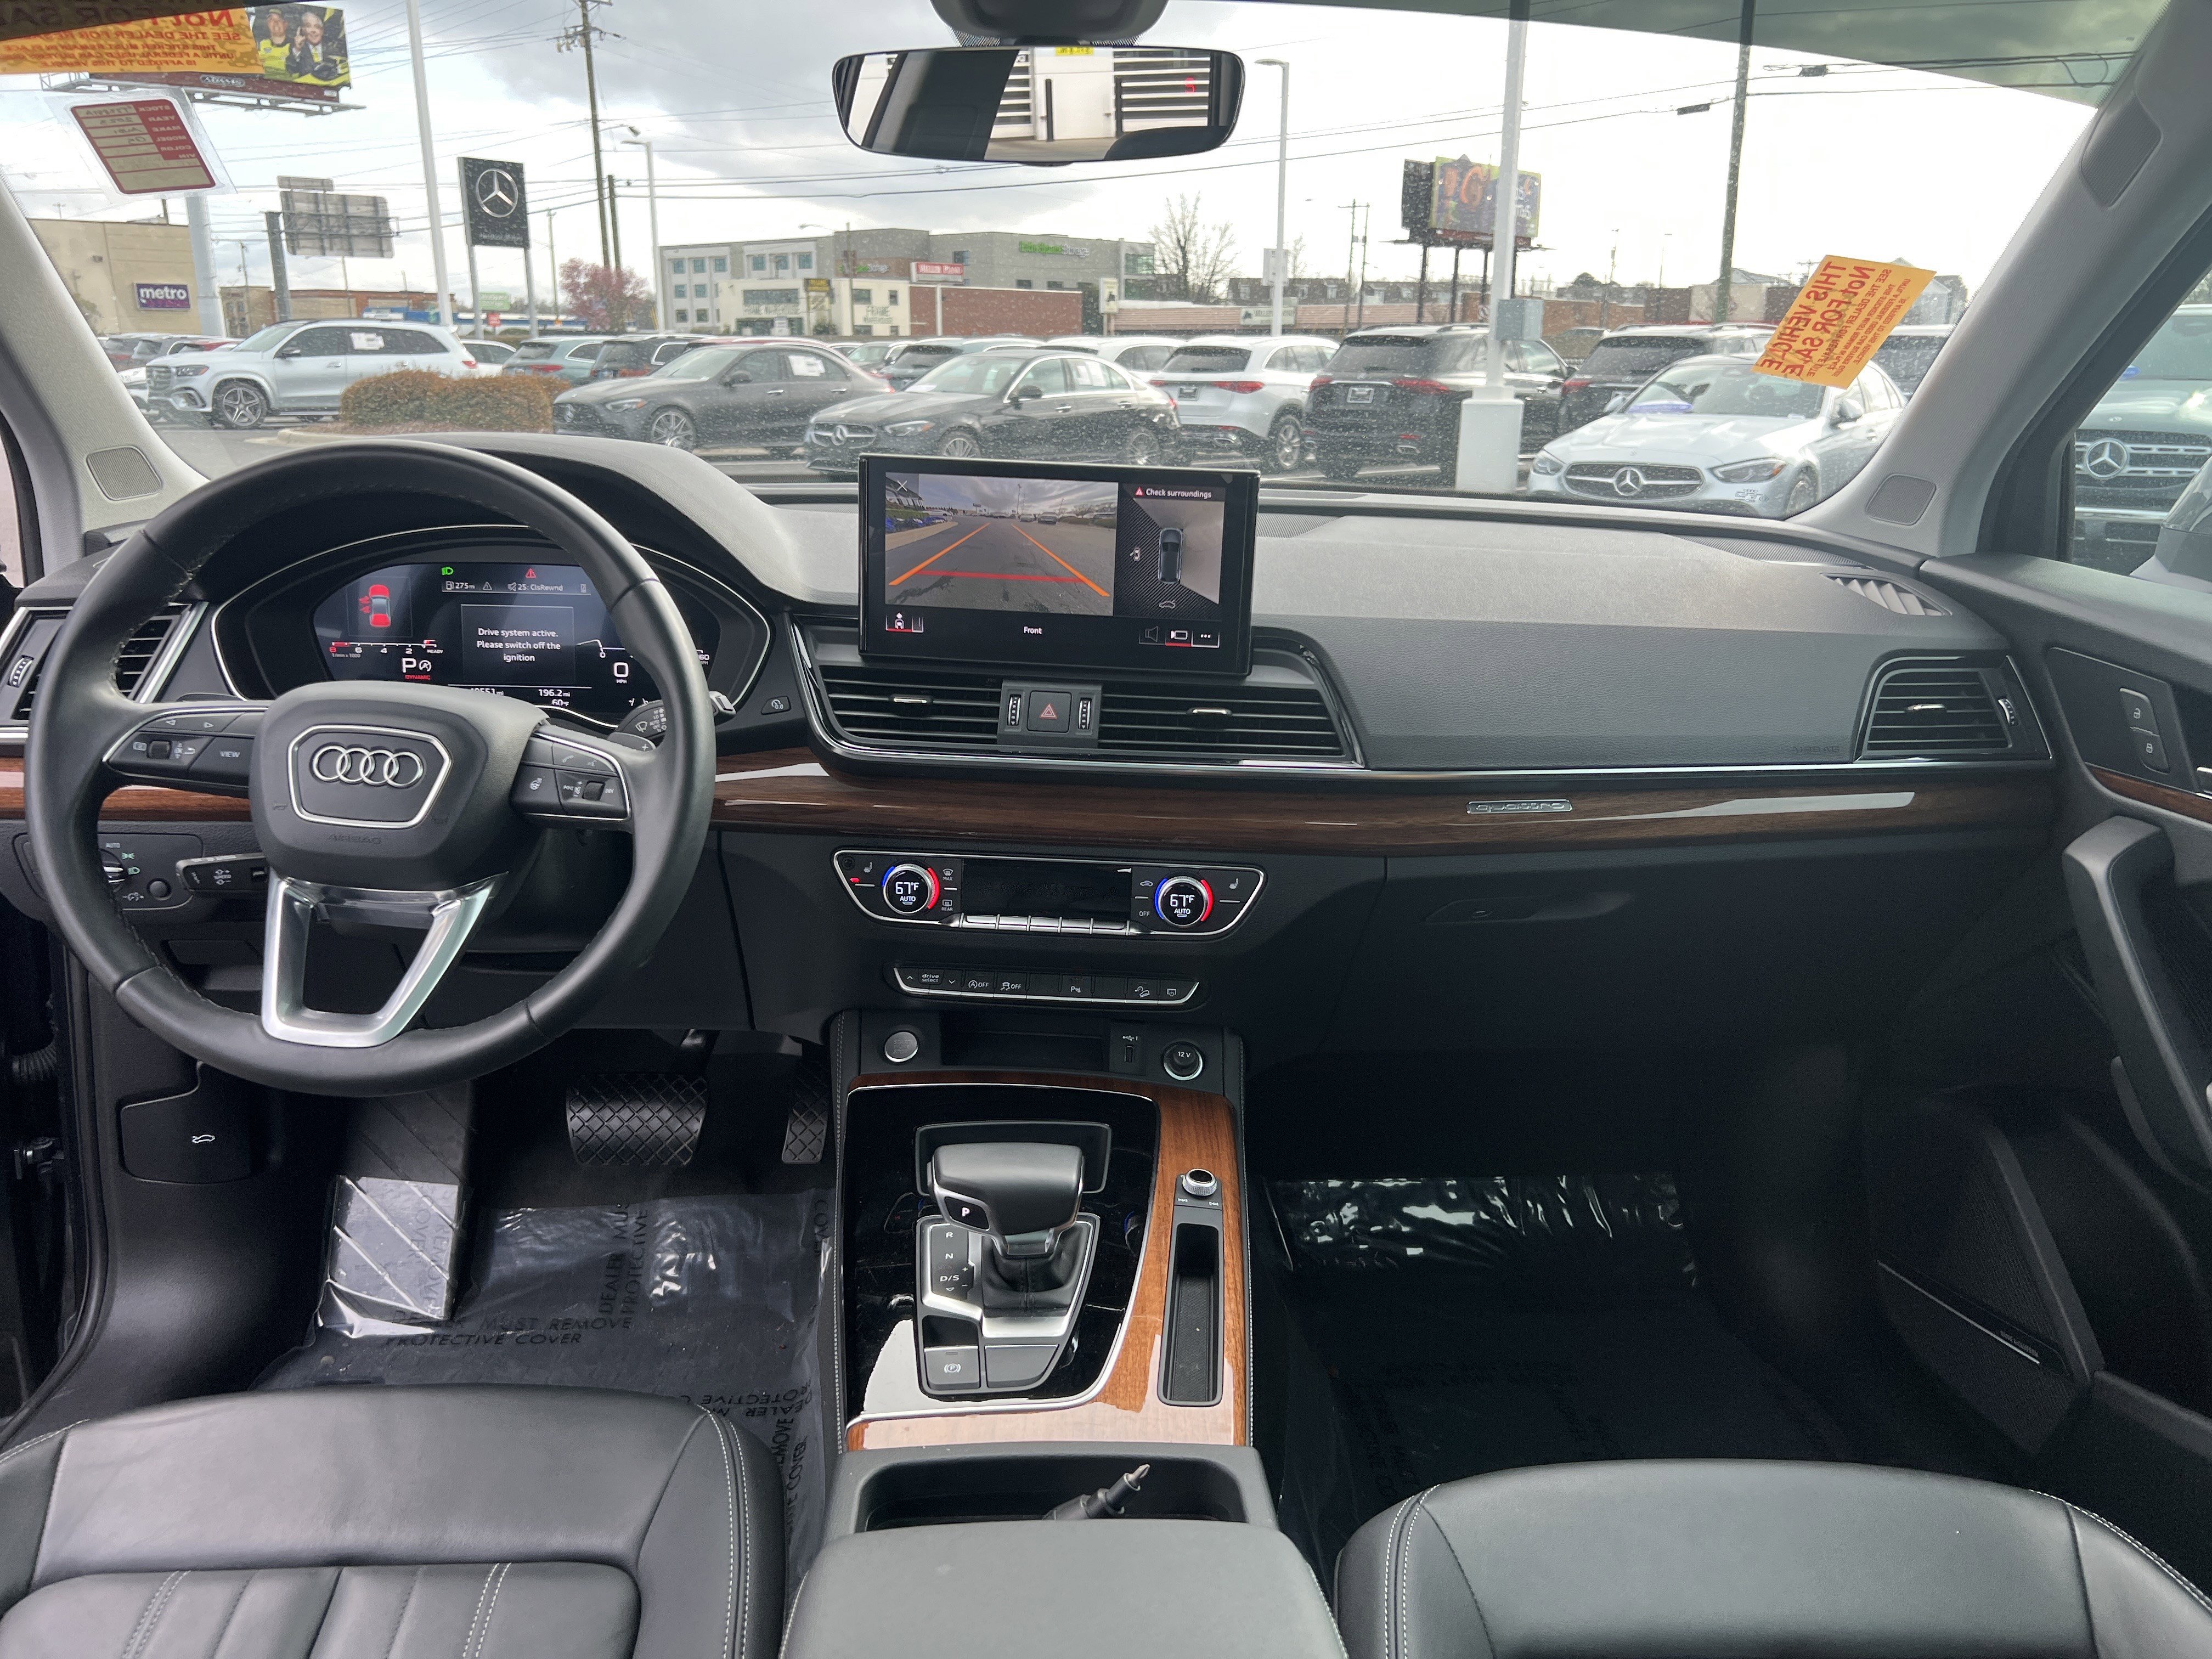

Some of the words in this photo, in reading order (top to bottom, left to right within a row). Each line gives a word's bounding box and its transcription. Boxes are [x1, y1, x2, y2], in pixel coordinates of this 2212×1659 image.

[139, 286, 187, 300] metro
[1146, 488, 1166, 496] Check
[1167, 489, 1212, 499] surroundings
[1023, 625, 1042, 635] Front
[504, 653, 535, 663] ignition
[402, 658, 417, 673] P
[613, 662, 629, 678] 0
[1476, 803, 1565, 812] quattro
[895, 882, 919, 895] 67°F
[1170, 894, 1195, 907] 67°F
[962, 1207, 970, 1217] P
[598, 1252, 626, 1313] DEALER
[549, 1317, 631, 1331] REMOVE
[385, 1333, 508, 1346] PROTECTIVE
[515, 1333, 582, 1345] COVER
